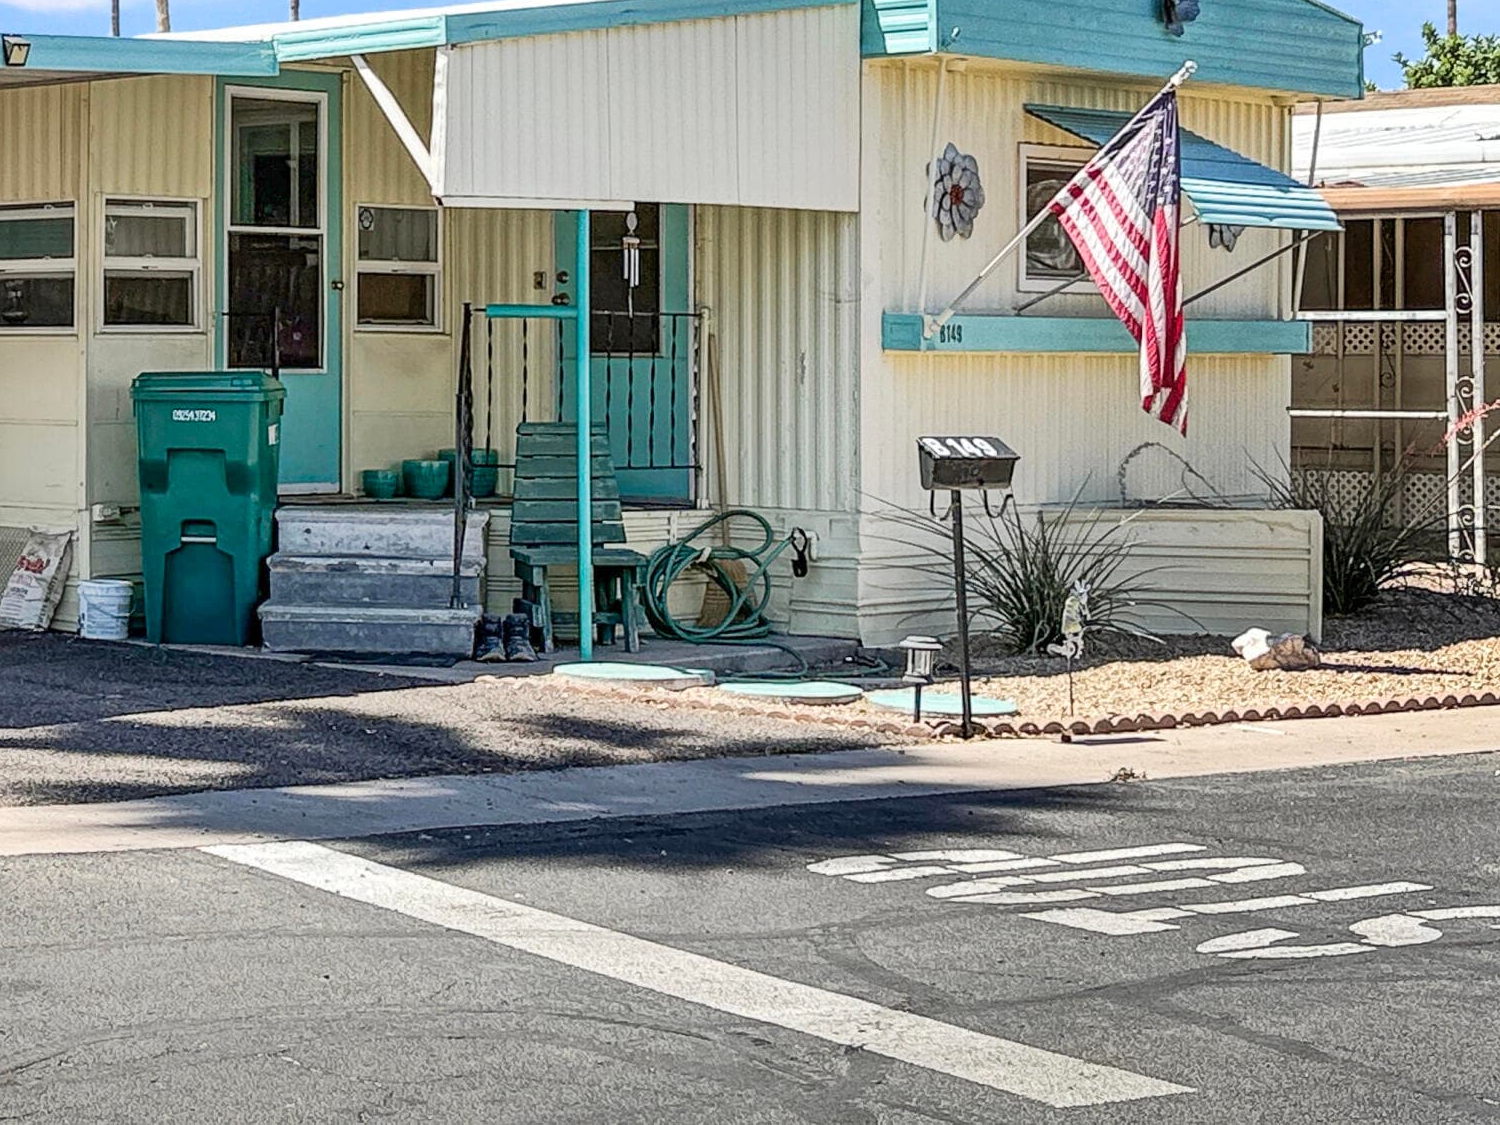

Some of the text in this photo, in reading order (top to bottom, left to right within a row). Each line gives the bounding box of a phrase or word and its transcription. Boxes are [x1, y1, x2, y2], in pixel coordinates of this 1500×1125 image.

[940, 325, 962, 343] B149
[921, 437, 998, 457] B149
[806, 842, 1500, 960] STOP
